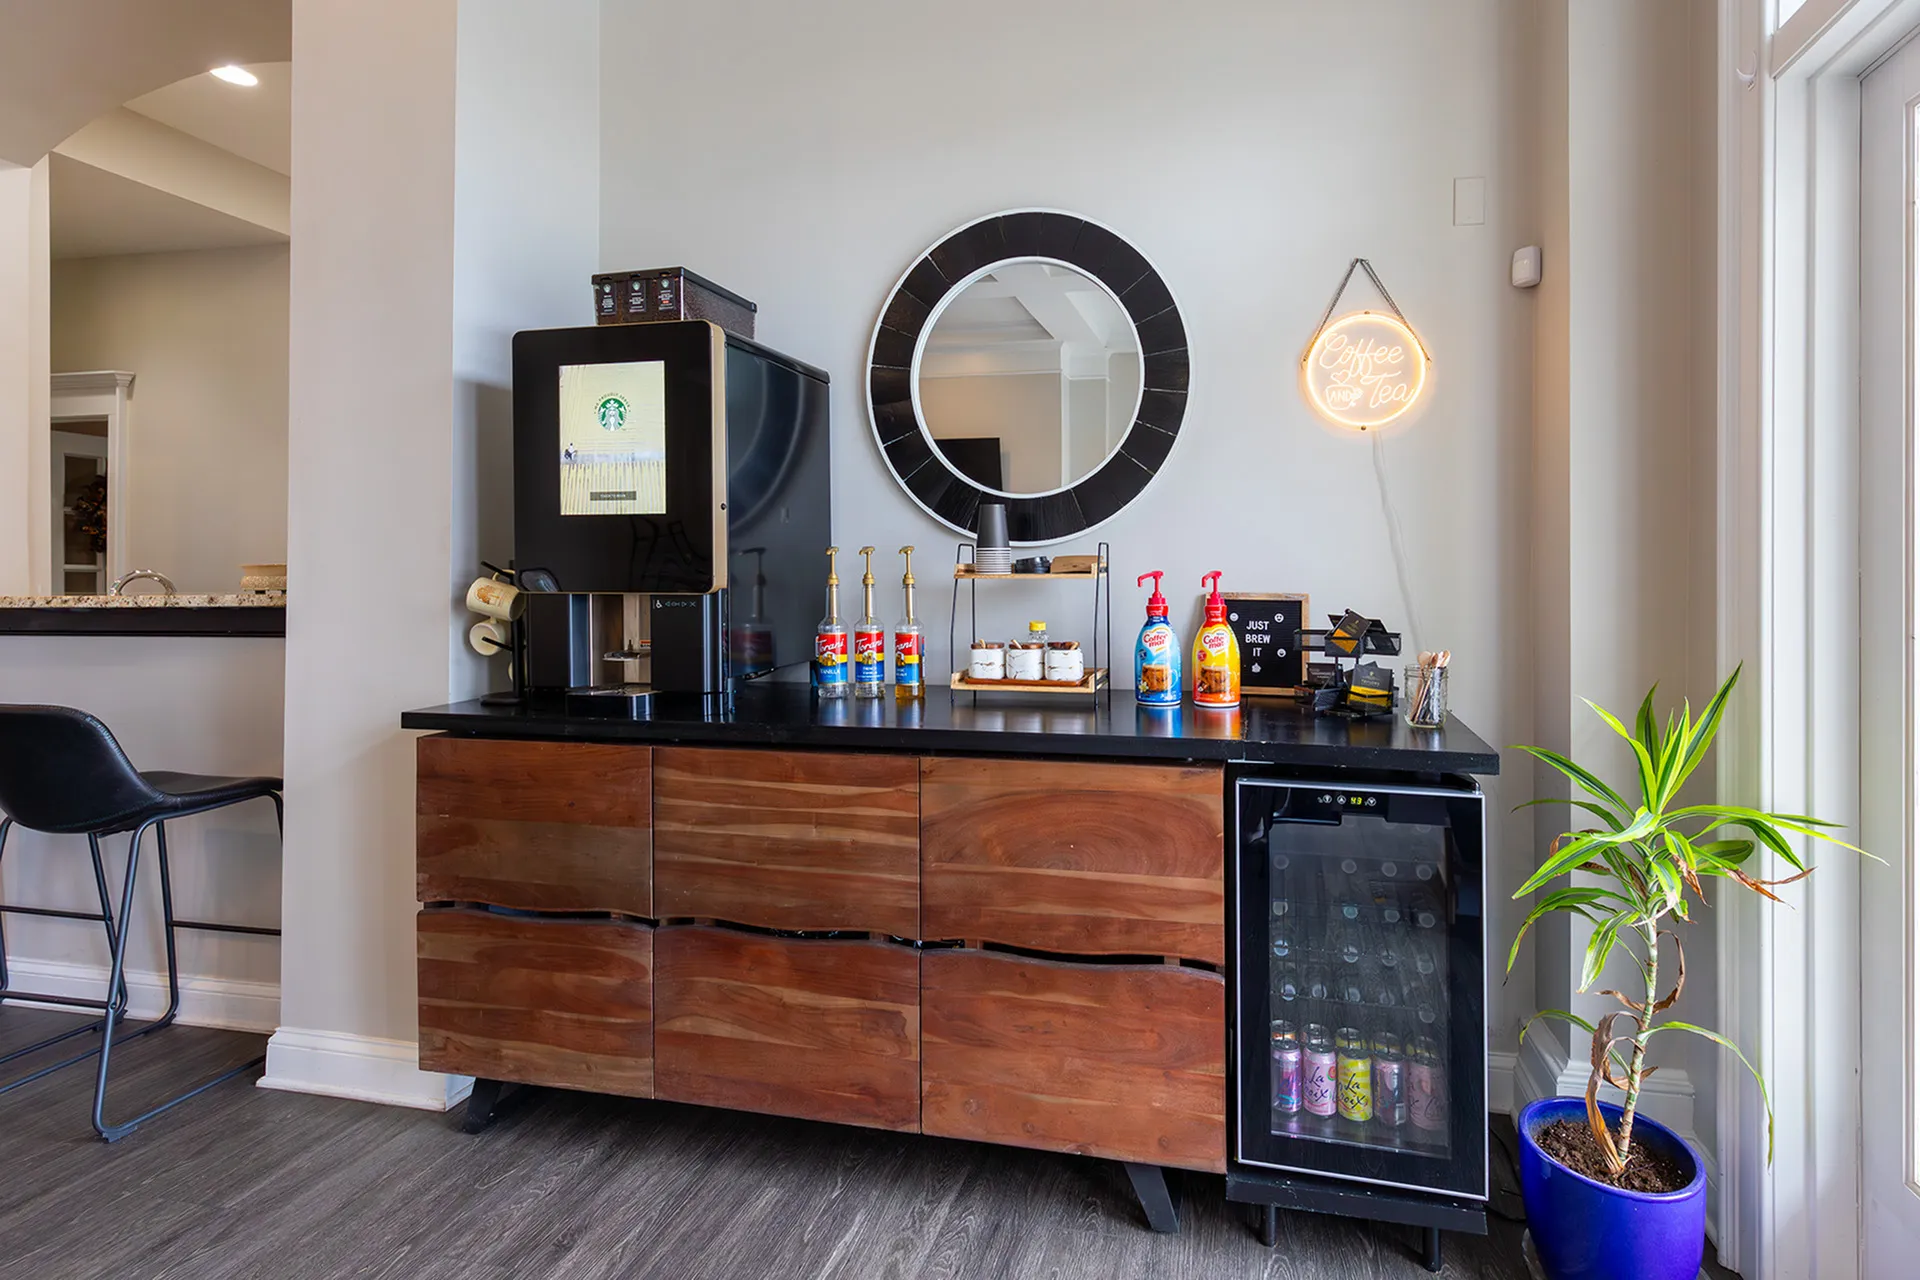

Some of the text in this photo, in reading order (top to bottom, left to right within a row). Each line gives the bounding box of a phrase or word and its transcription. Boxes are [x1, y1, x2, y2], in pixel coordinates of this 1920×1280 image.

[1319, 332, 1405, 378] Coffee
[1329, 371, 1414, 408] AND Tea
[1246, 620, 1270, 630] JUST
[856, 636, 884, 654] Torani
[1245, 633, 1271, 644] BREW
[1252, 647, 1262, 657] IT
[1350, 796, 1363, 805] 43
[1309, 1066, 1325, 1088] La
[1343, 1072, 1361, 1095] La
